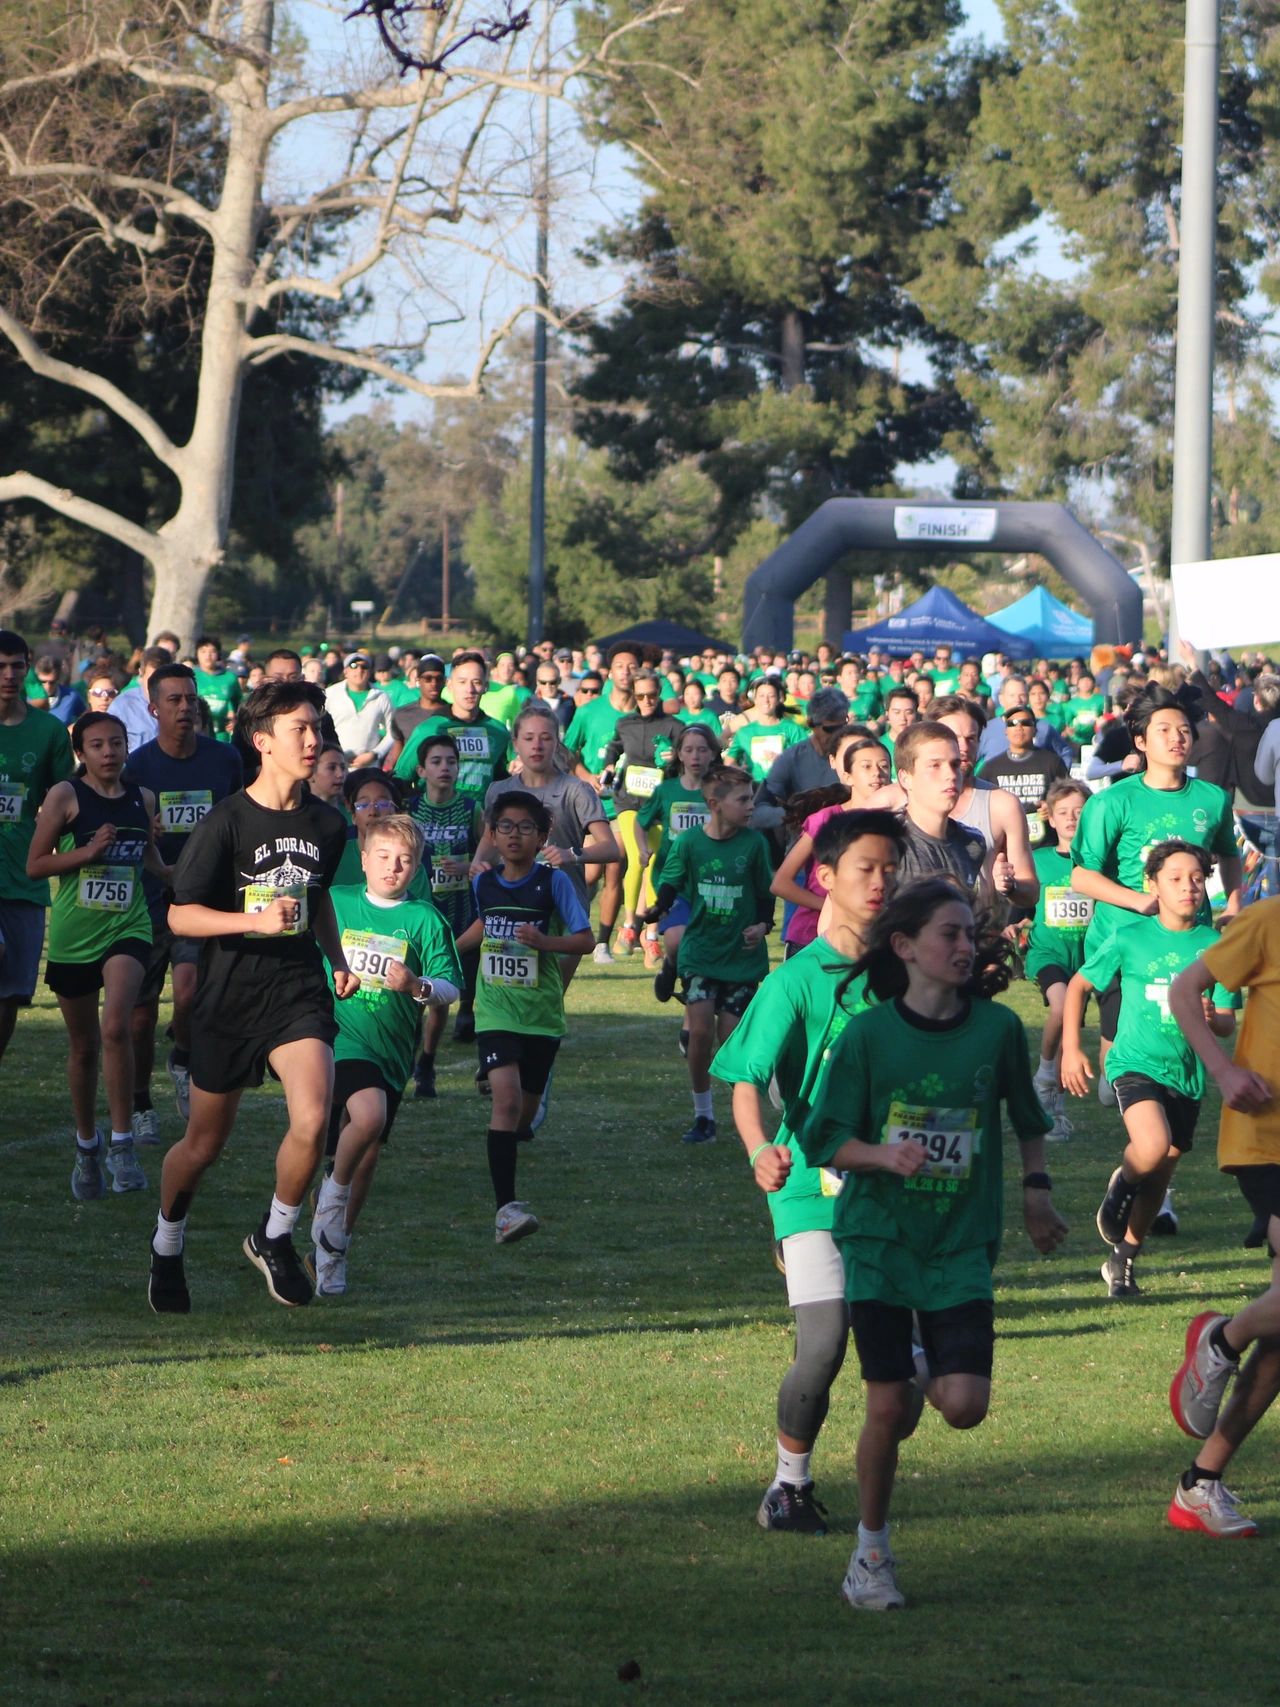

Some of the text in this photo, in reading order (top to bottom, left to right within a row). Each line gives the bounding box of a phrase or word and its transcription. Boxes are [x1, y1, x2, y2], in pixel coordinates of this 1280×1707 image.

[918, 524, 967, 537] FINISH
[457, 739, 483, 751] 1160
[997, 774, 1044, 788] VALADEZ
[167, 806, 207, 824] 1736
[104, 840, 148, 857] ICK
[254, 838, 320, 864] EL DORADO
[86, 881, 127, 901] 1756
[1052, 901, 1088, 918] 1396
[488, 956, 528, 977] 1195
